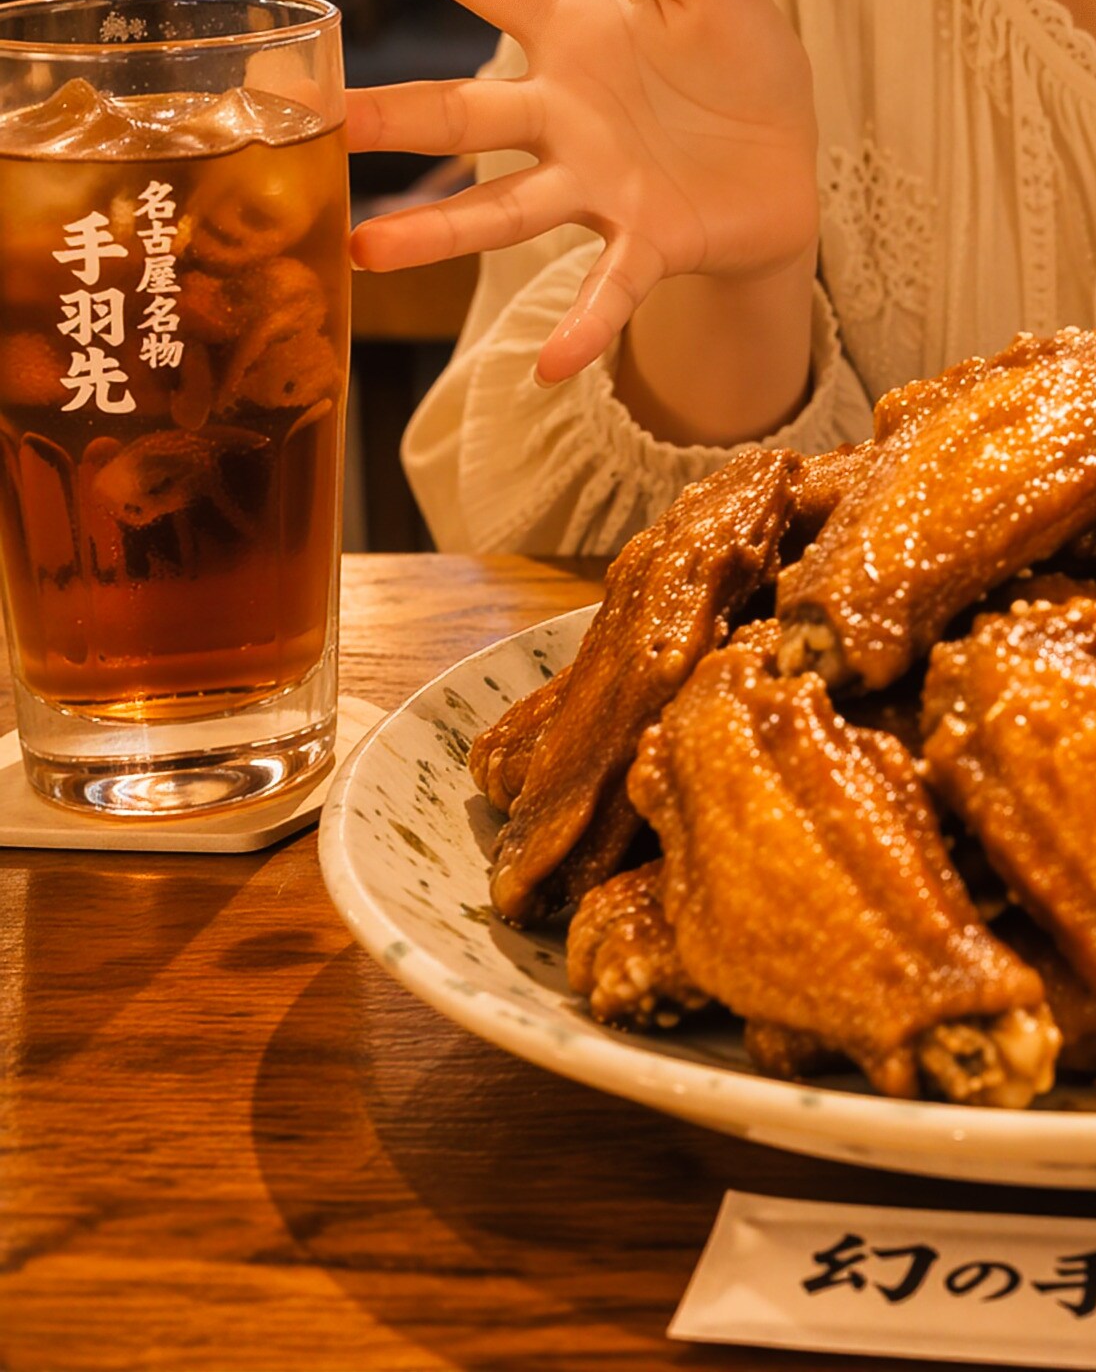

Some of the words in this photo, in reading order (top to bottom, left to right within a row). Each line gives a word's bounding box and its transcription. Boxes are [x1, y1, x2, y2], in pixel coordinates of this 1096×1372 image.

[52, 211, 137, 414] 手羽先
[133, 180, 185, 369] 名古屋名物
